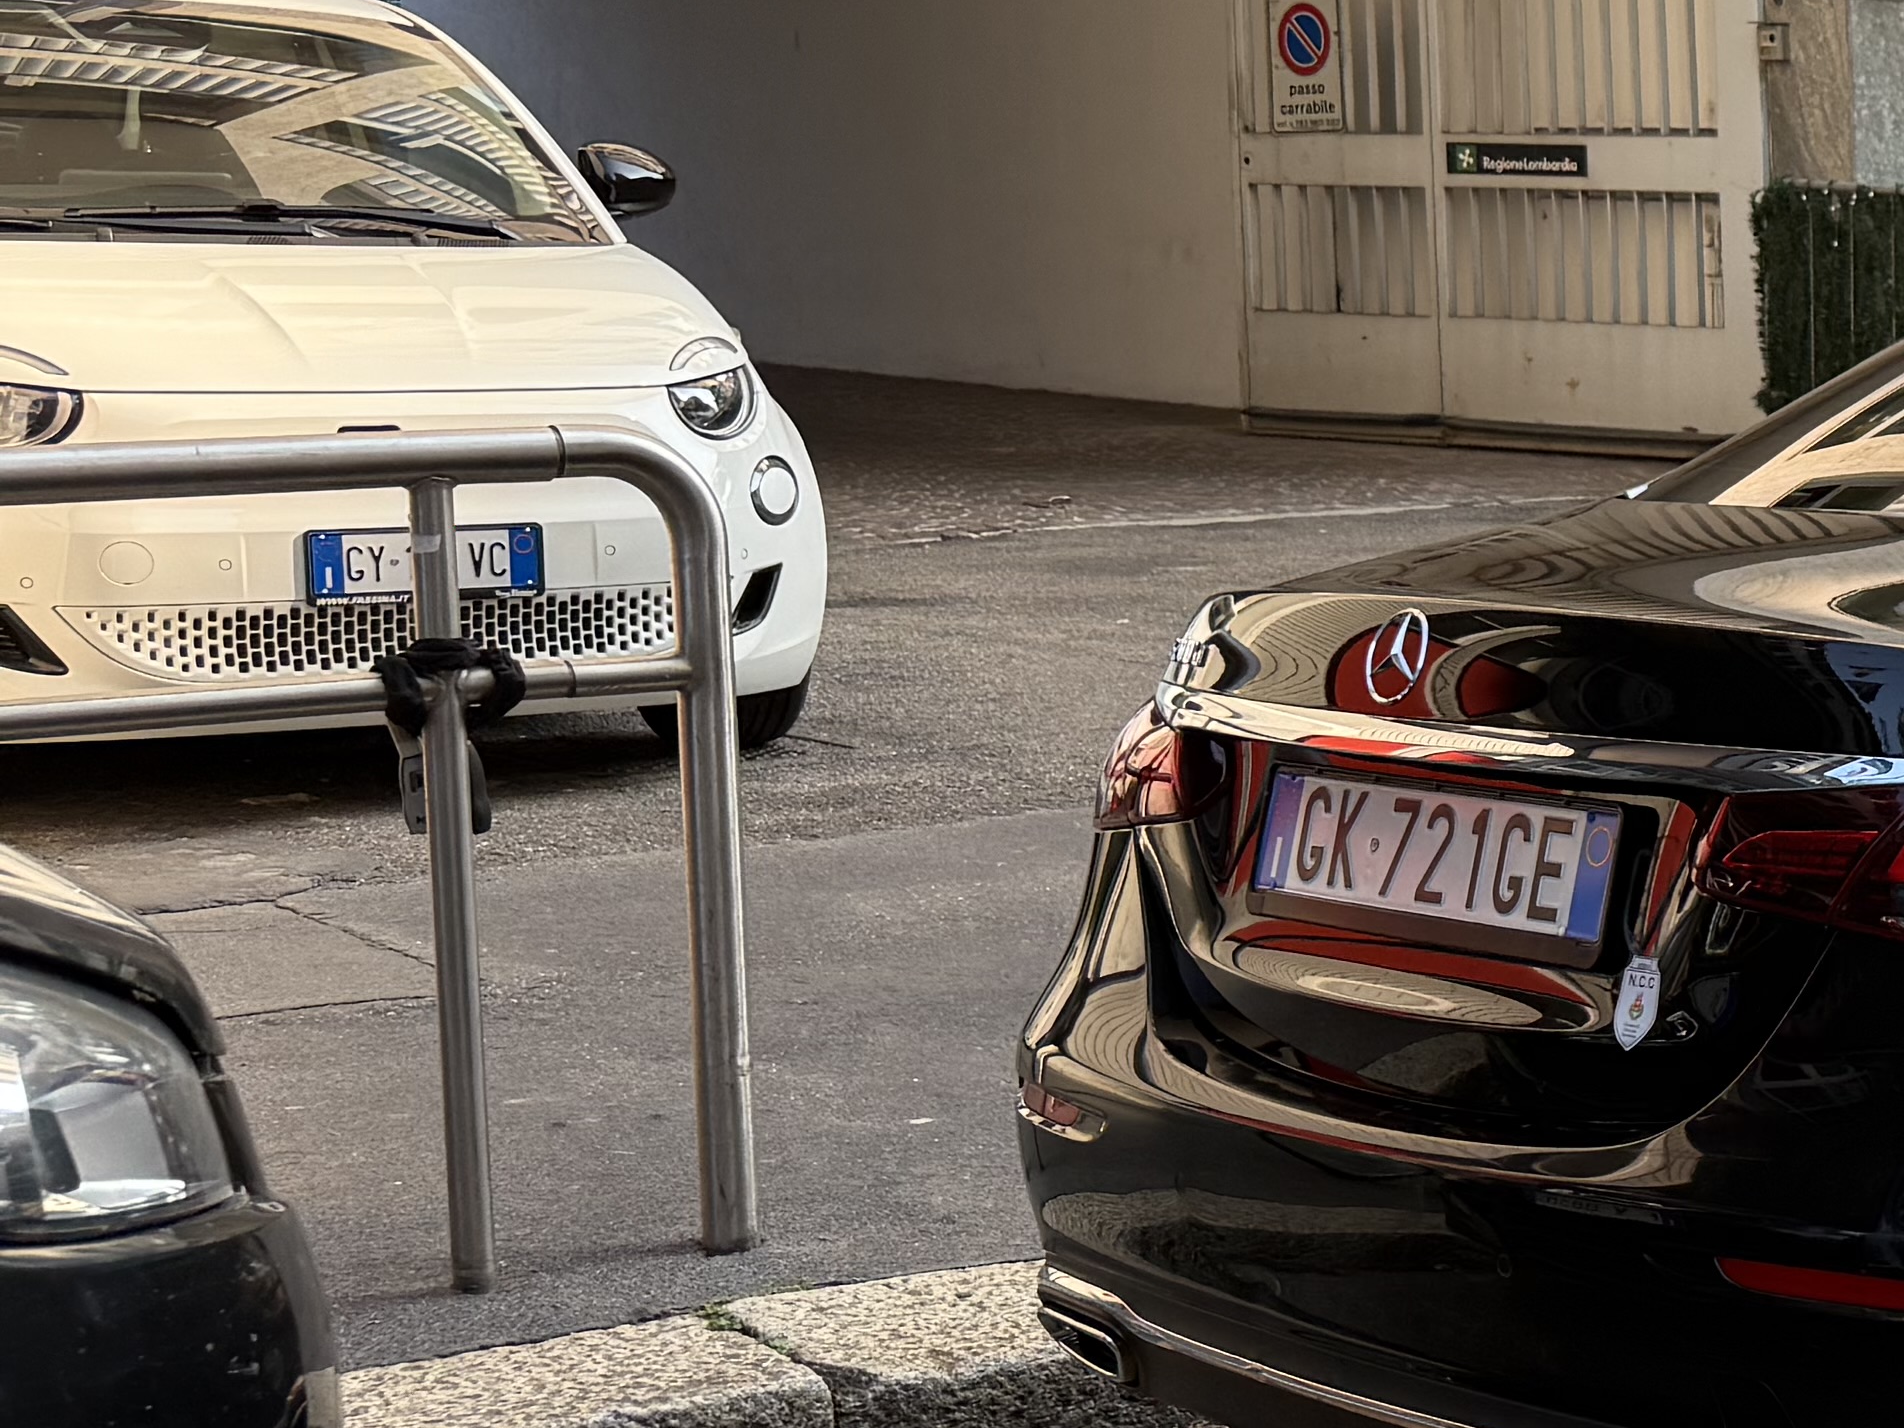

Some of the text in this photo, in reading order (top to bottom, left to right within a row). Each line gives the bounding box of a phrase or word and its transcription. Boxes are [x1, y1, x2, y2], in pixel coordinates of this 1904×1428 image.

[1289, 83, 1326, 98] passo
[1280, 100, 1336, 116] carrabile
[1296, 785, 1369, 890] GK
[1378, 798, 1577, 922] 721GE
